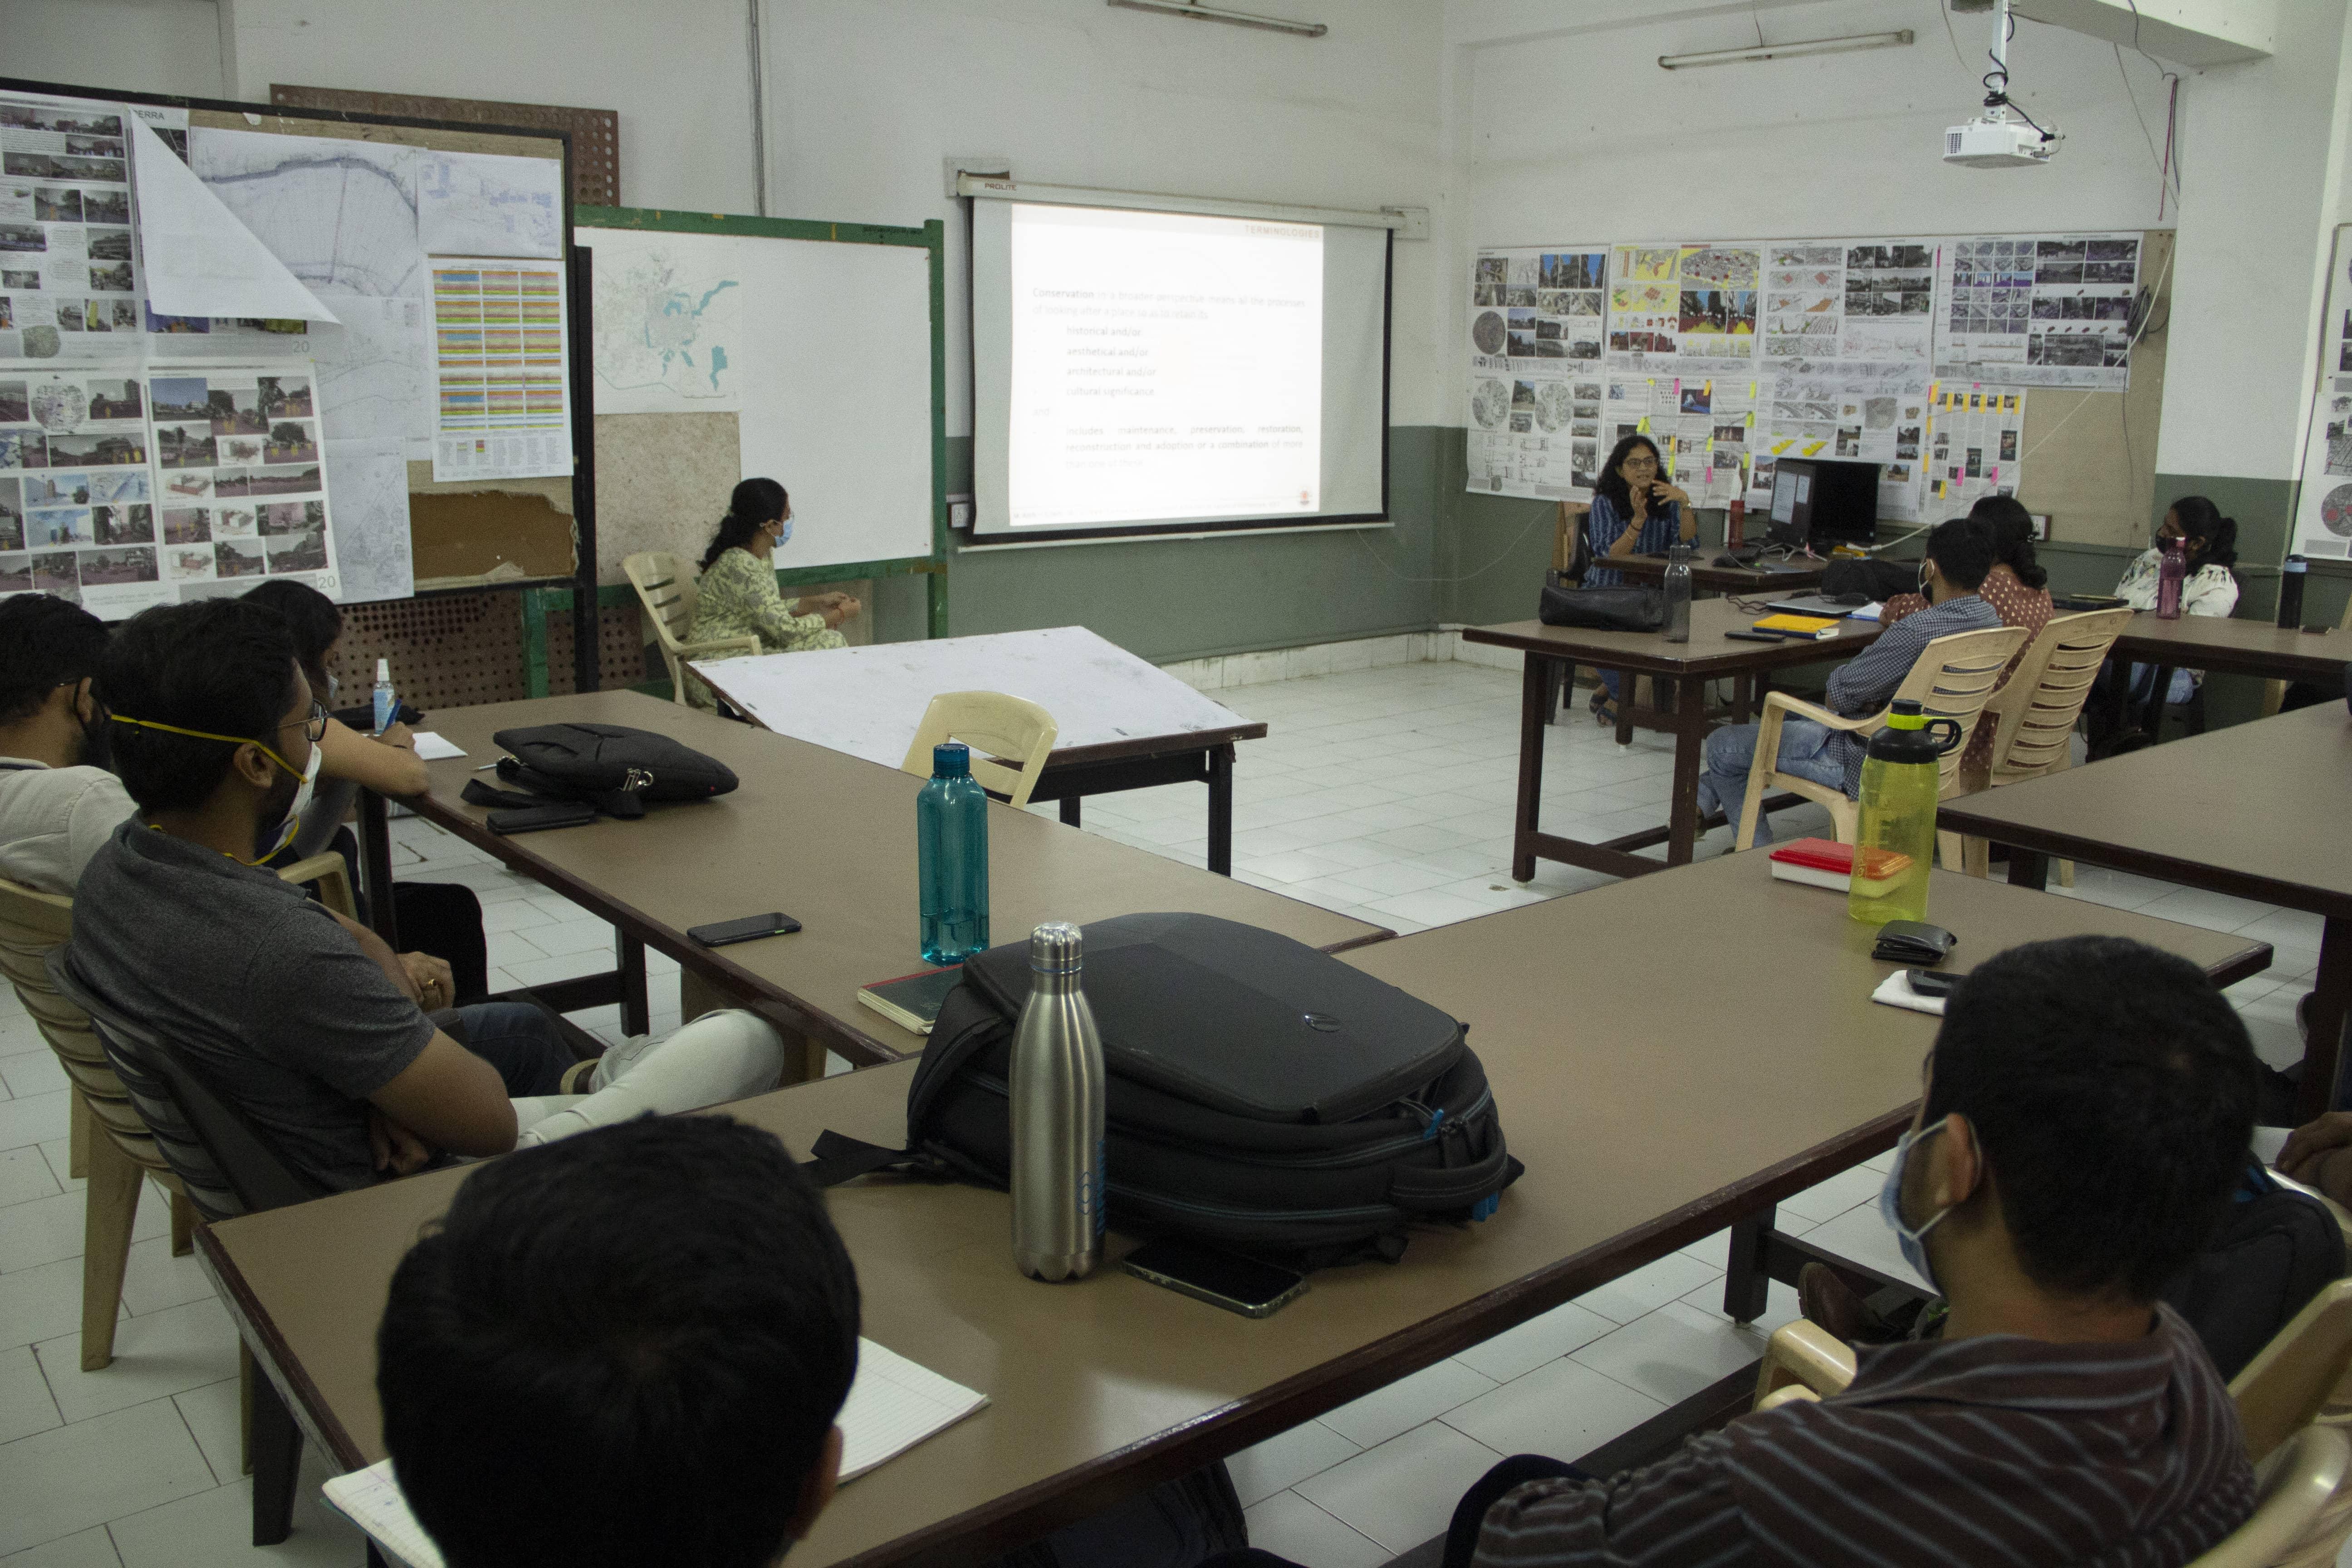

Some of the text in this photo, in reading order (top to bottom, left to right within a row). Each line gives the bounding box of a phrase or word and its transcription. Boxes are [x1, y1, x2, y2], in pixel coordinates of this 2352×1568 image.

[134, 109, 165, 120] ERRA
[1245, 225, 1319, 239] TERMINOLOGIES
[1033, 288, 1095, 298] Conservation
[1098, 289, 1106, 299] in
[1118, 290, 1154, 301] broader
[1209, 296, 1235, 304] means
[1238, 294, 1248, 305] all
[1250, 294, 1264, 306] the
[1267, 297, 1305, 308] processes
[1033, 304, 1042, 314] of
[1045, 304, 1078, 317] looking
[1080, 305, 1102, 315] after
[1112, 306, 1135, 318] place
[1149, 309, 1159, 318] as
[1172, 309, 1196, 319] retain
[1066, 325, 1142, 337] historical and/or
[294, 341, 309, 353] 20
[1066, 346, 1149, 358] aesthetical and/or
[1066, 367, 1156, 378] architectural and/or
[1066, 385, 1155, 398] cultural significance
[1032, 407, 1049, 416] and
[1066, 425, 1303, 436] includes maintenance, preservation, restoration,
[1066, 441, 1132, 452] reconstruction
[1135, 441, 1152, 451] and
[1156, 440, 1194, 452] adoption
[1197, 441, 1206, 450] or
[1218, 439, 1269, 449] combination
[1271, 439, 1280, 449] of
[1283, 441, 1303, 449] more
[318, 575, 335, 588] 20
